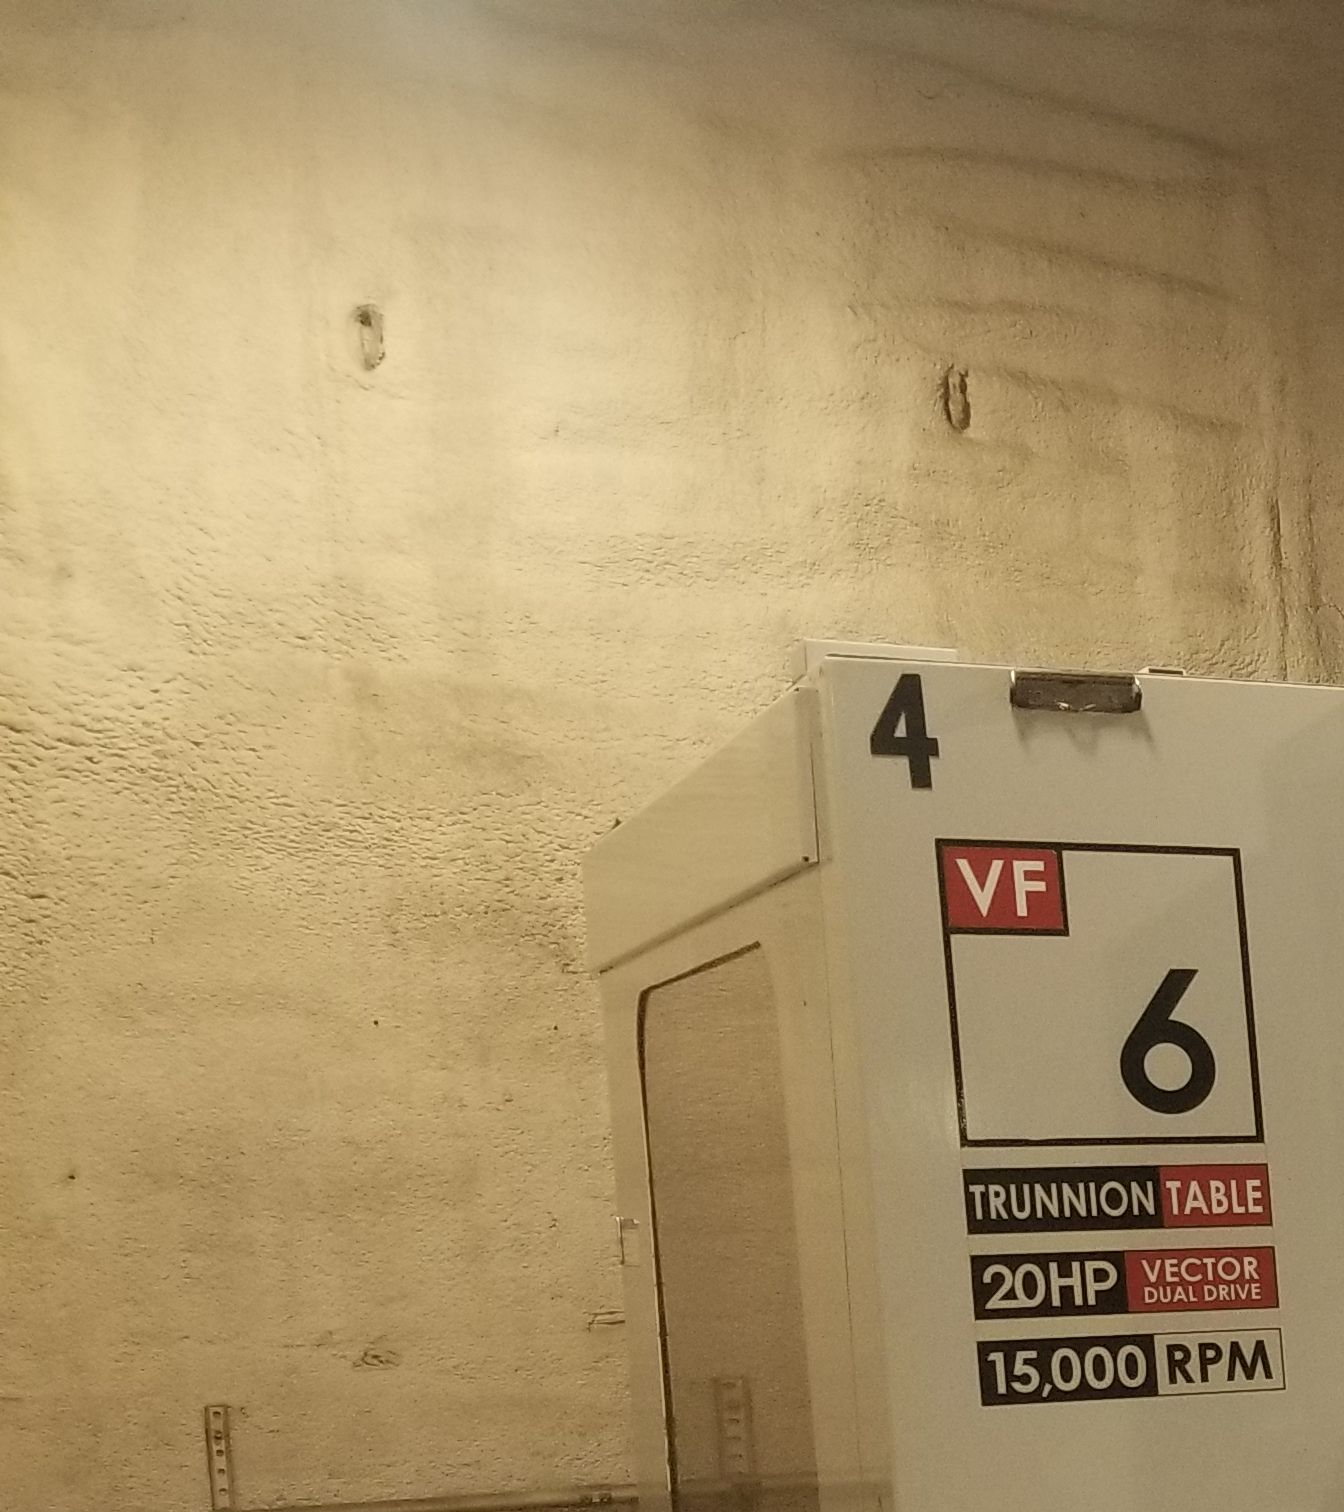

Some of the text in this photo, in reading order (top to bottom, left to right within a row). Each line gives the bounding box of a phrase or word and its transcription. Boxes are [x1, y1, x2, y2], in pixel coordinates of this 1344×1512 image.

[870, 673, 939, 789] 4
[955, 858, 1047, 918] VF
[1120, 968, 1216, 1114] 6
[968, 1179, 1264, 1220] TRUNNION TABLE
[982, 1260, 1118, 1310] 20HP
[1141, 1256, 1260, 1283] VECTOR
[1143, 1283, 1262, 1304] DUAL DRIVE
[987, 1339, 1274, 1398] 15,000 RPM
